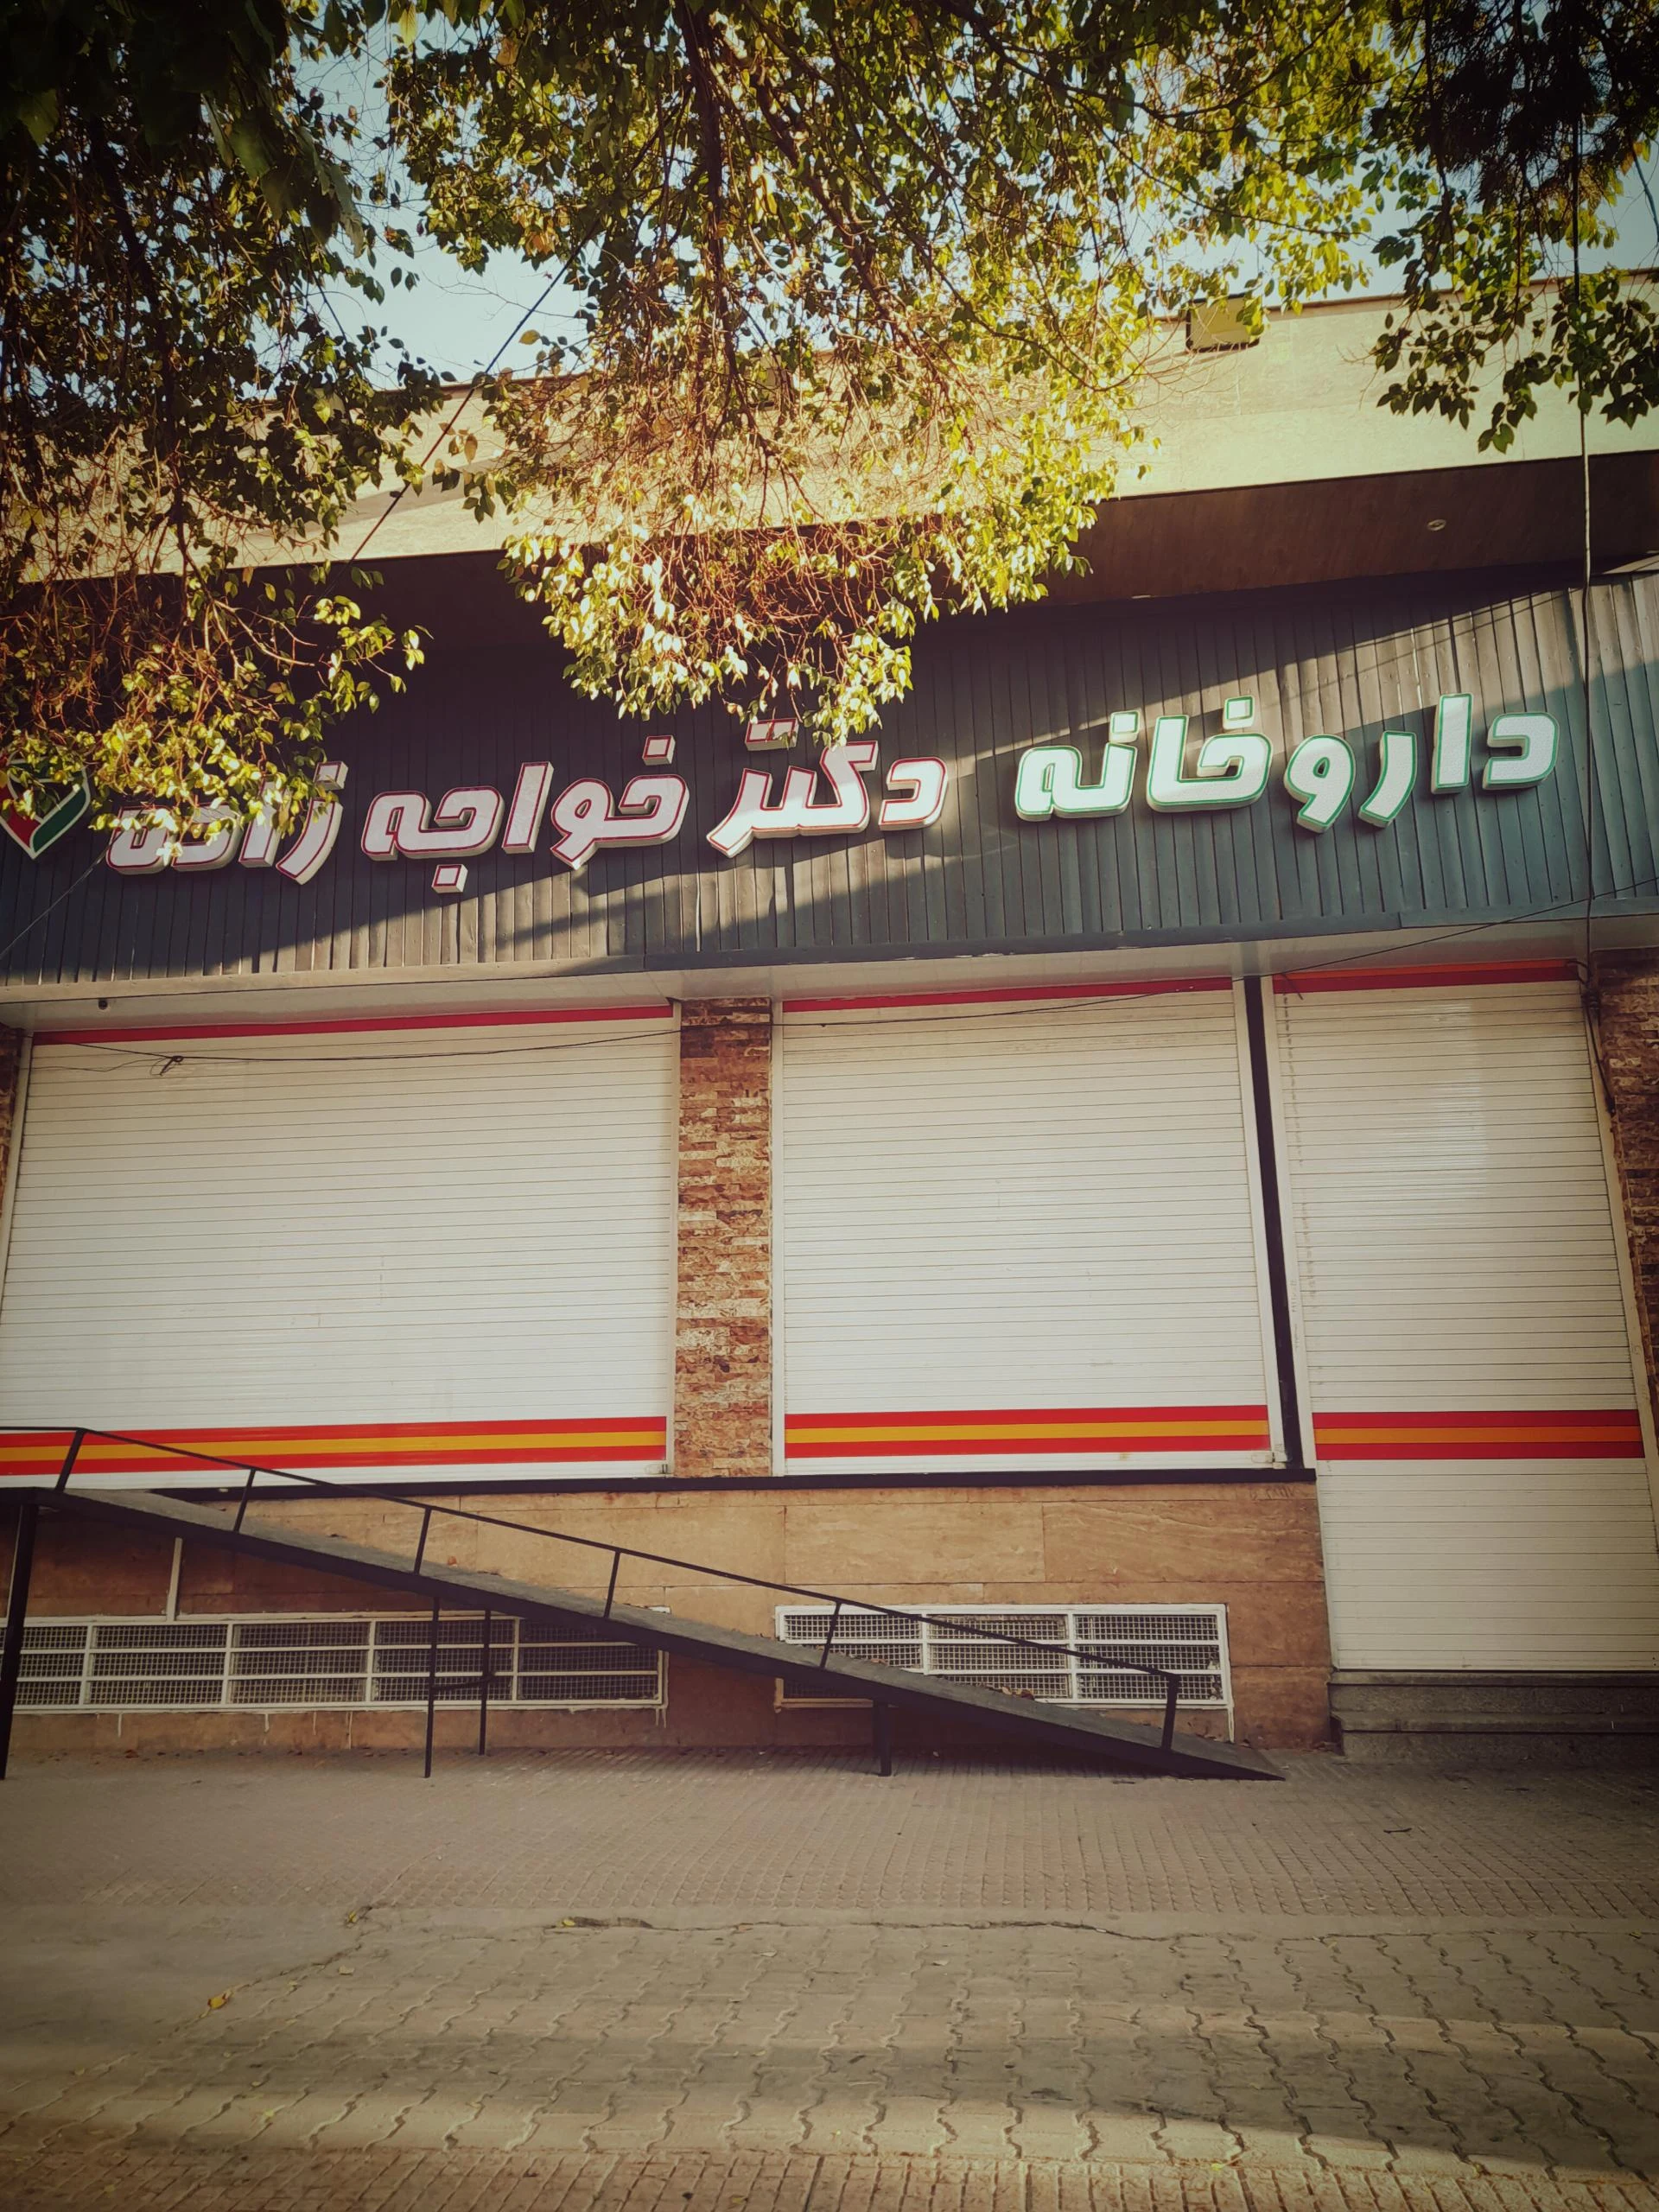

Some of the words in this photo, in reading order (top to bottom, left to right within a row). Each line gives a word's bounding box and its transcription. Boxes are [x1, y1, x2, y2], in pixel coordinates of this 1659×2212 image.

[105, 760, 347, 885] زاده
[360, 734, 690, 893] خواجه
[706, 718, 949, 858] دکتر
[1014, 693, 1559, 834] داروخانه
